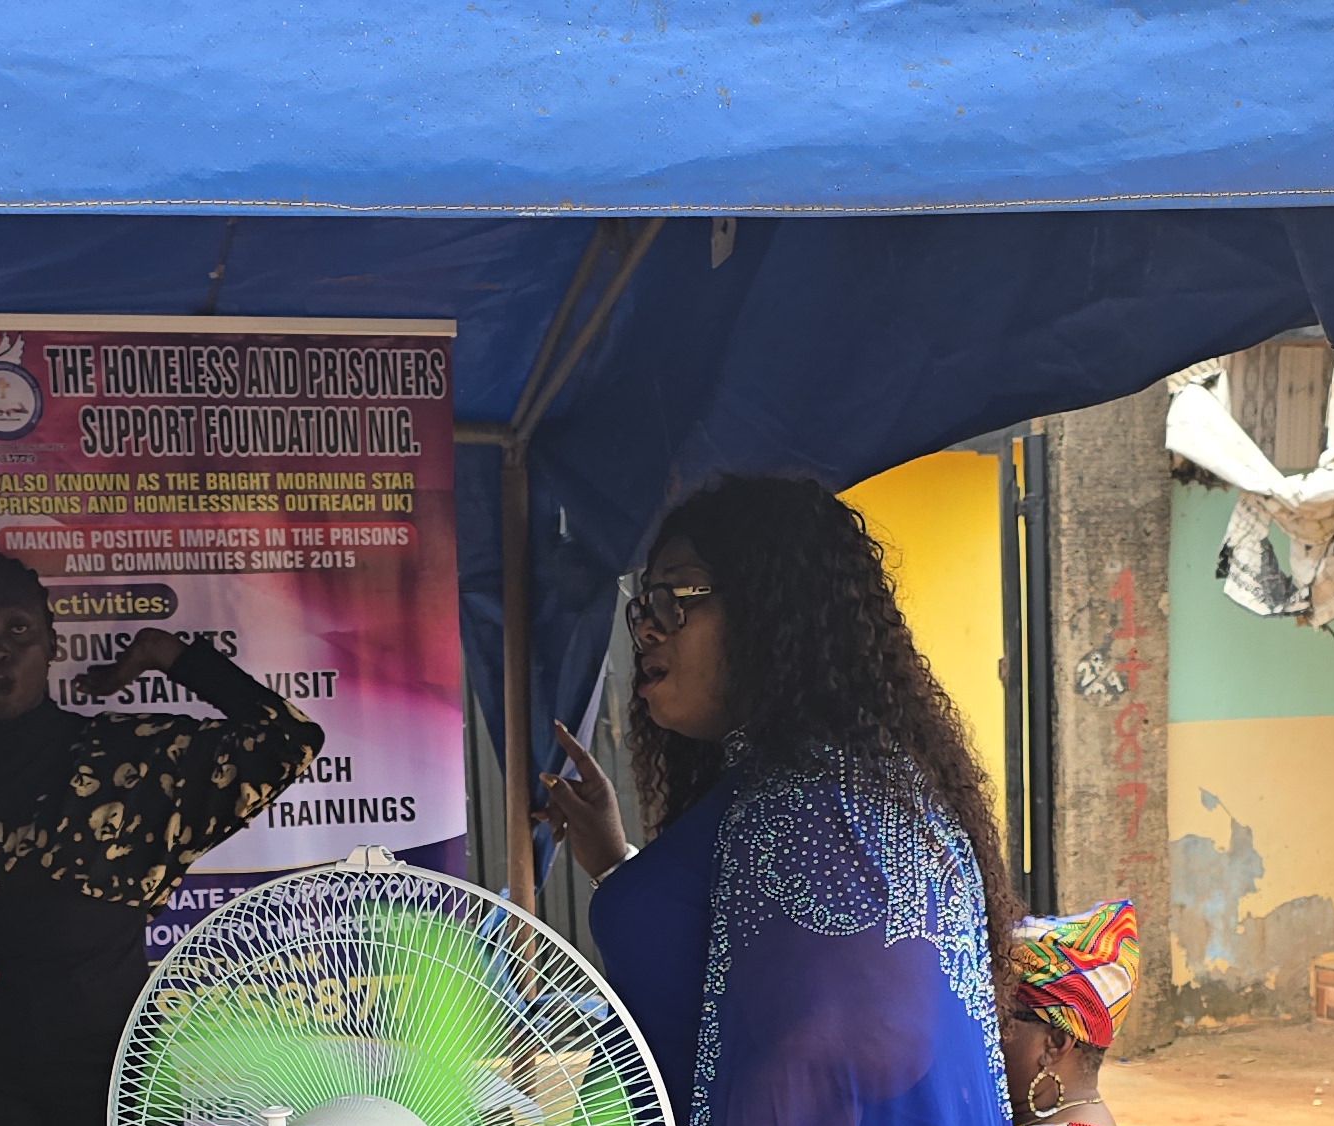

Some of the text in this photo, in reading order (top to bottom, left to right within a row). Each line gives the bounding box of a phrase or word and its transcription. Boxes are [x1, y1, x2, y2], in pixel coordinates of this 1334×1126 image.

[44, 346, 96, 397] THE
[101, 345, 240, 398] HOMELESS
[245, 346, 301, 397] AND
[305, 347, 446, 399] PRISONERS
[79, 405, 421, 457] SUPPORT FOUNDATION NIG.
[54, 473, 130, 491] KNOWN
[136, 473, 160, 491] AS
[165, 472, 200, 491] THE
[206, 472, 270, 490] BRIGHT
[276, 472, 365, 490] MORNING
[371, 472, 415, 490] STAR
[87, 495, 128, 513] AND
[133, 494, 279, 513] HOMELESSNESS
[285, 494, 375, 512] OUTREACH
[5, 526, 409, 550] MAKING POSITIVE IMPACTS IN THE PRISONS
[65, 550, 356, 572] AND COMMUNITIES SINCE 2015
[48, 591, 170, 615] ctivities:
[265, 671, 337, 698] VISIT
[268, 796, 416, 828] TRAININGS
